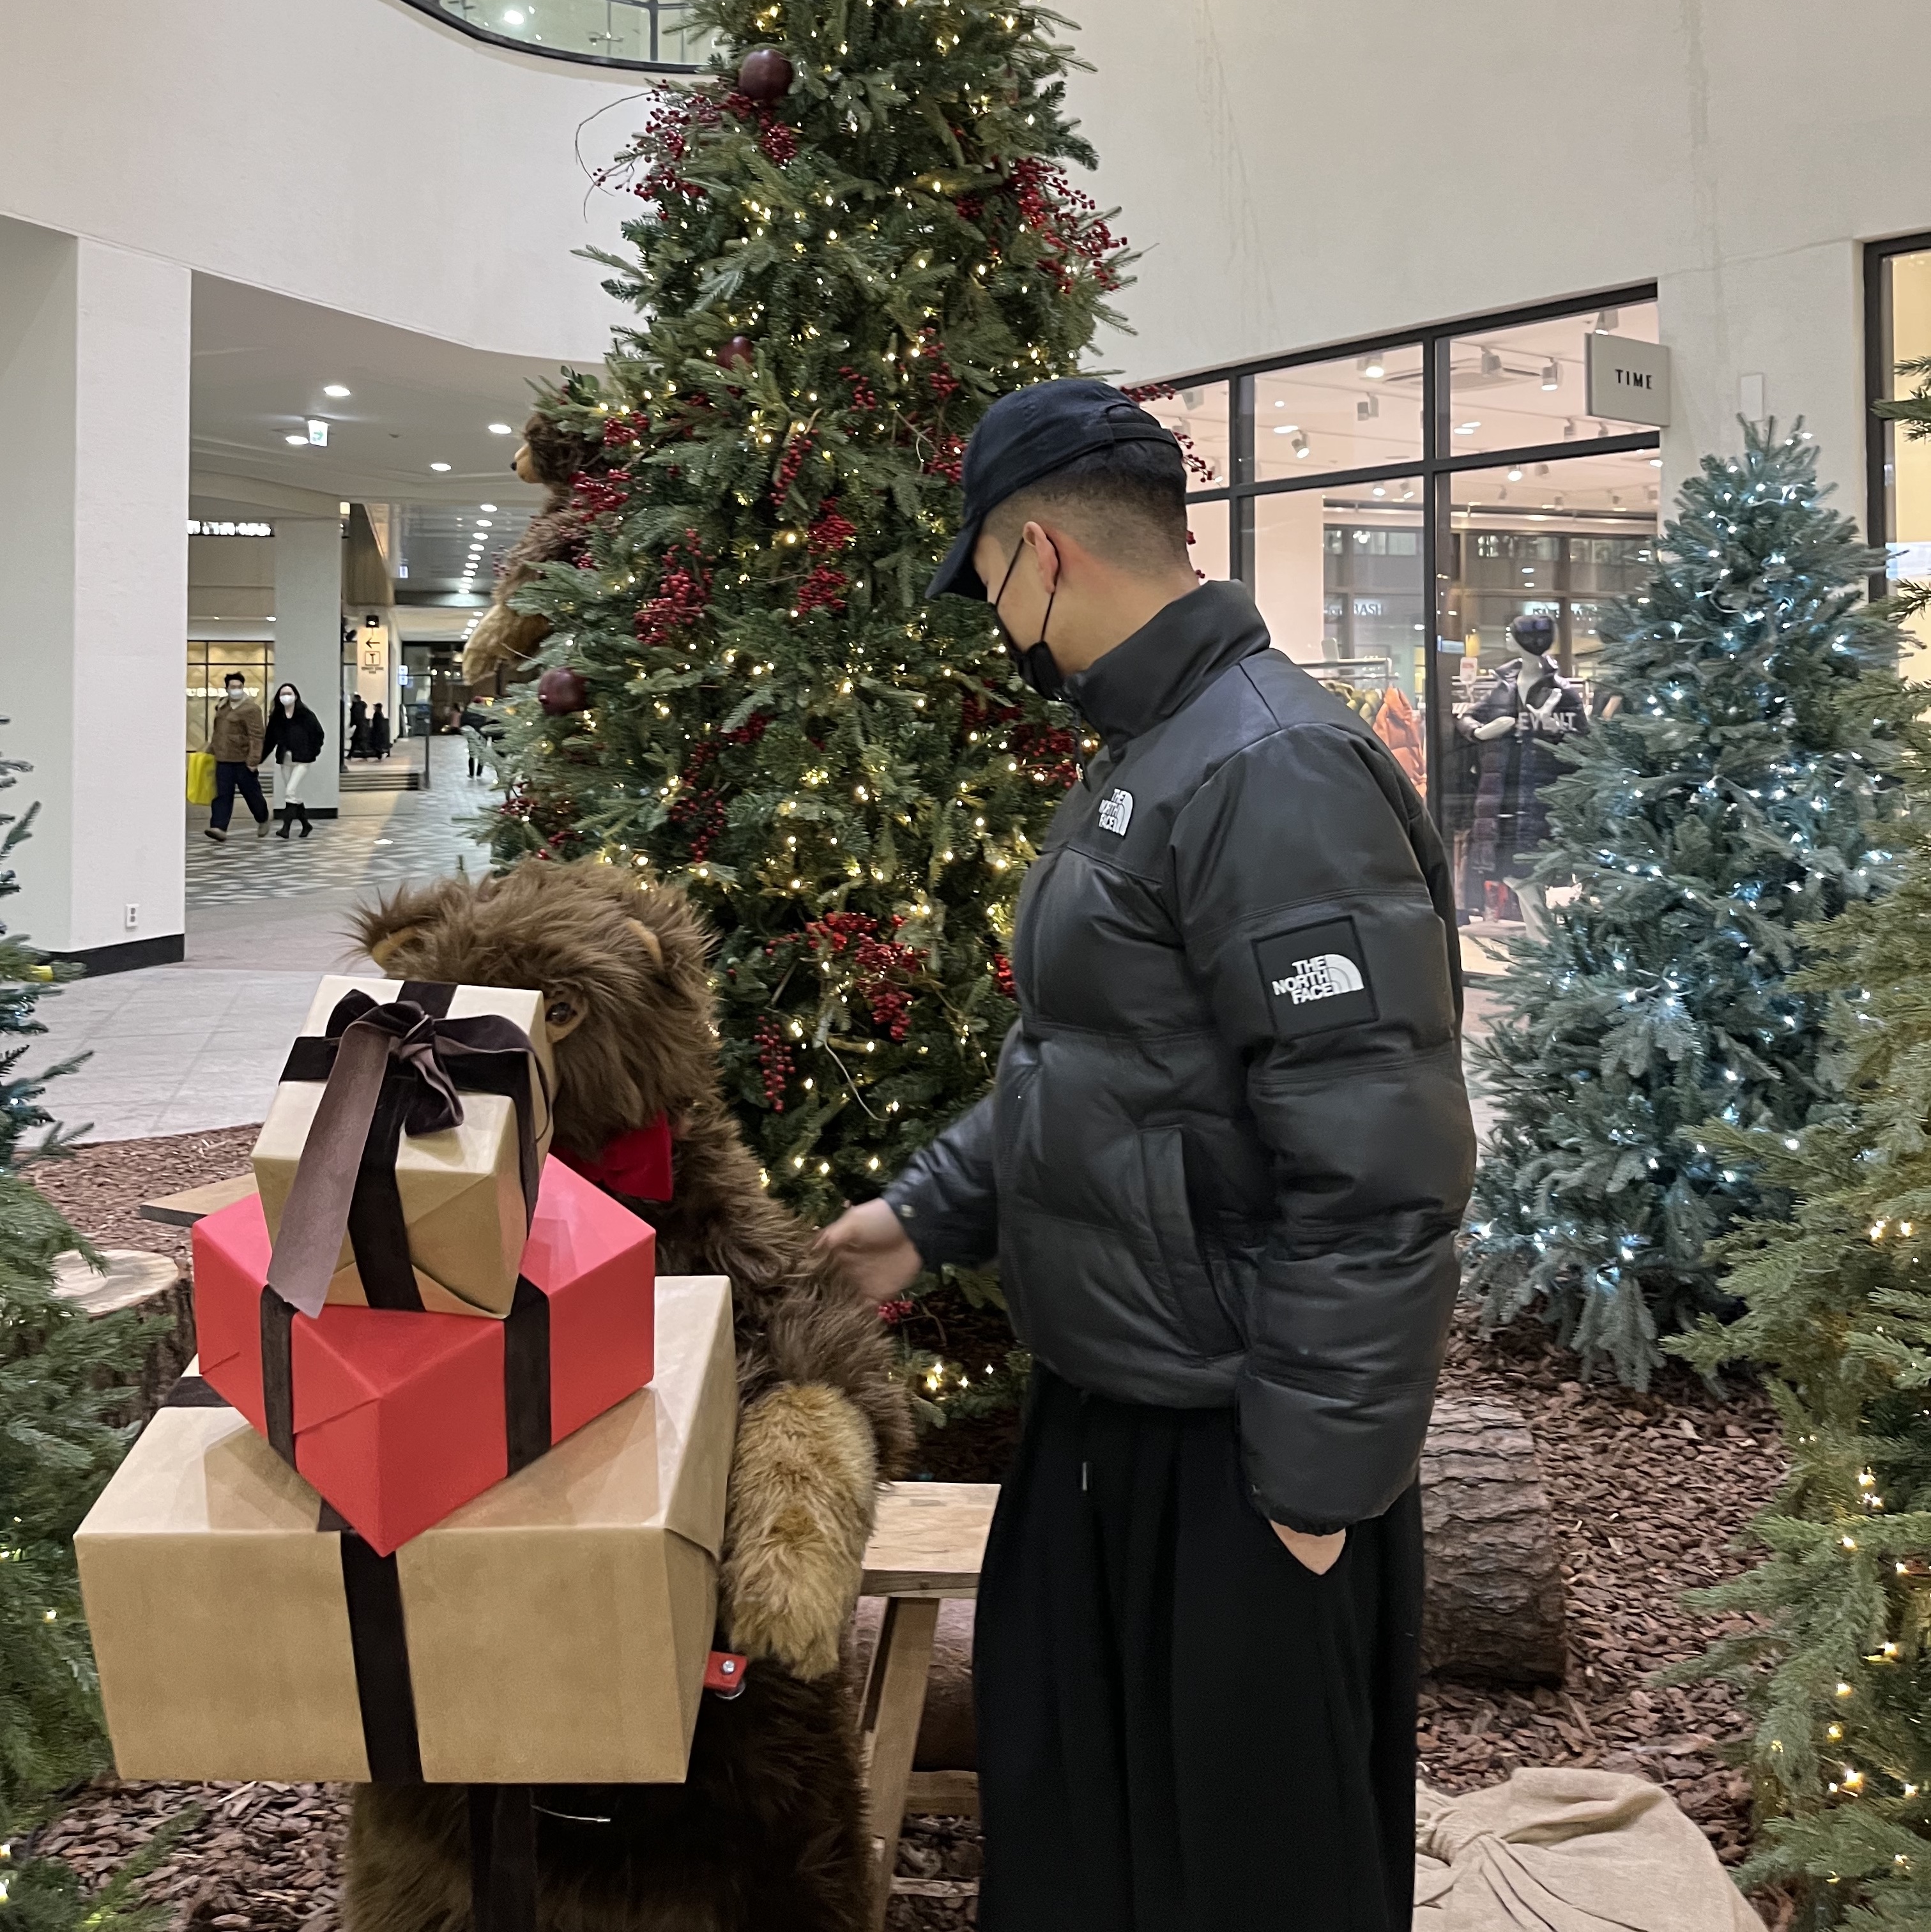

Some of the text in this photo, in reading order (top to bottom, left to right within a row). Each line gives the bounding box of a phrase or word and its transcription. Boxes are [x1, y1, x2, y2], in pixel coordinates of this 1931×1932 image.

[1615, 369, 1652, 390] TIME
[1111, 788, 1127, 804] THE
[1292, 955, 1327, 975] THE
[1272, 969, 1331, 995] NORTH
[1291, 982, 1334, 1005] FACE
